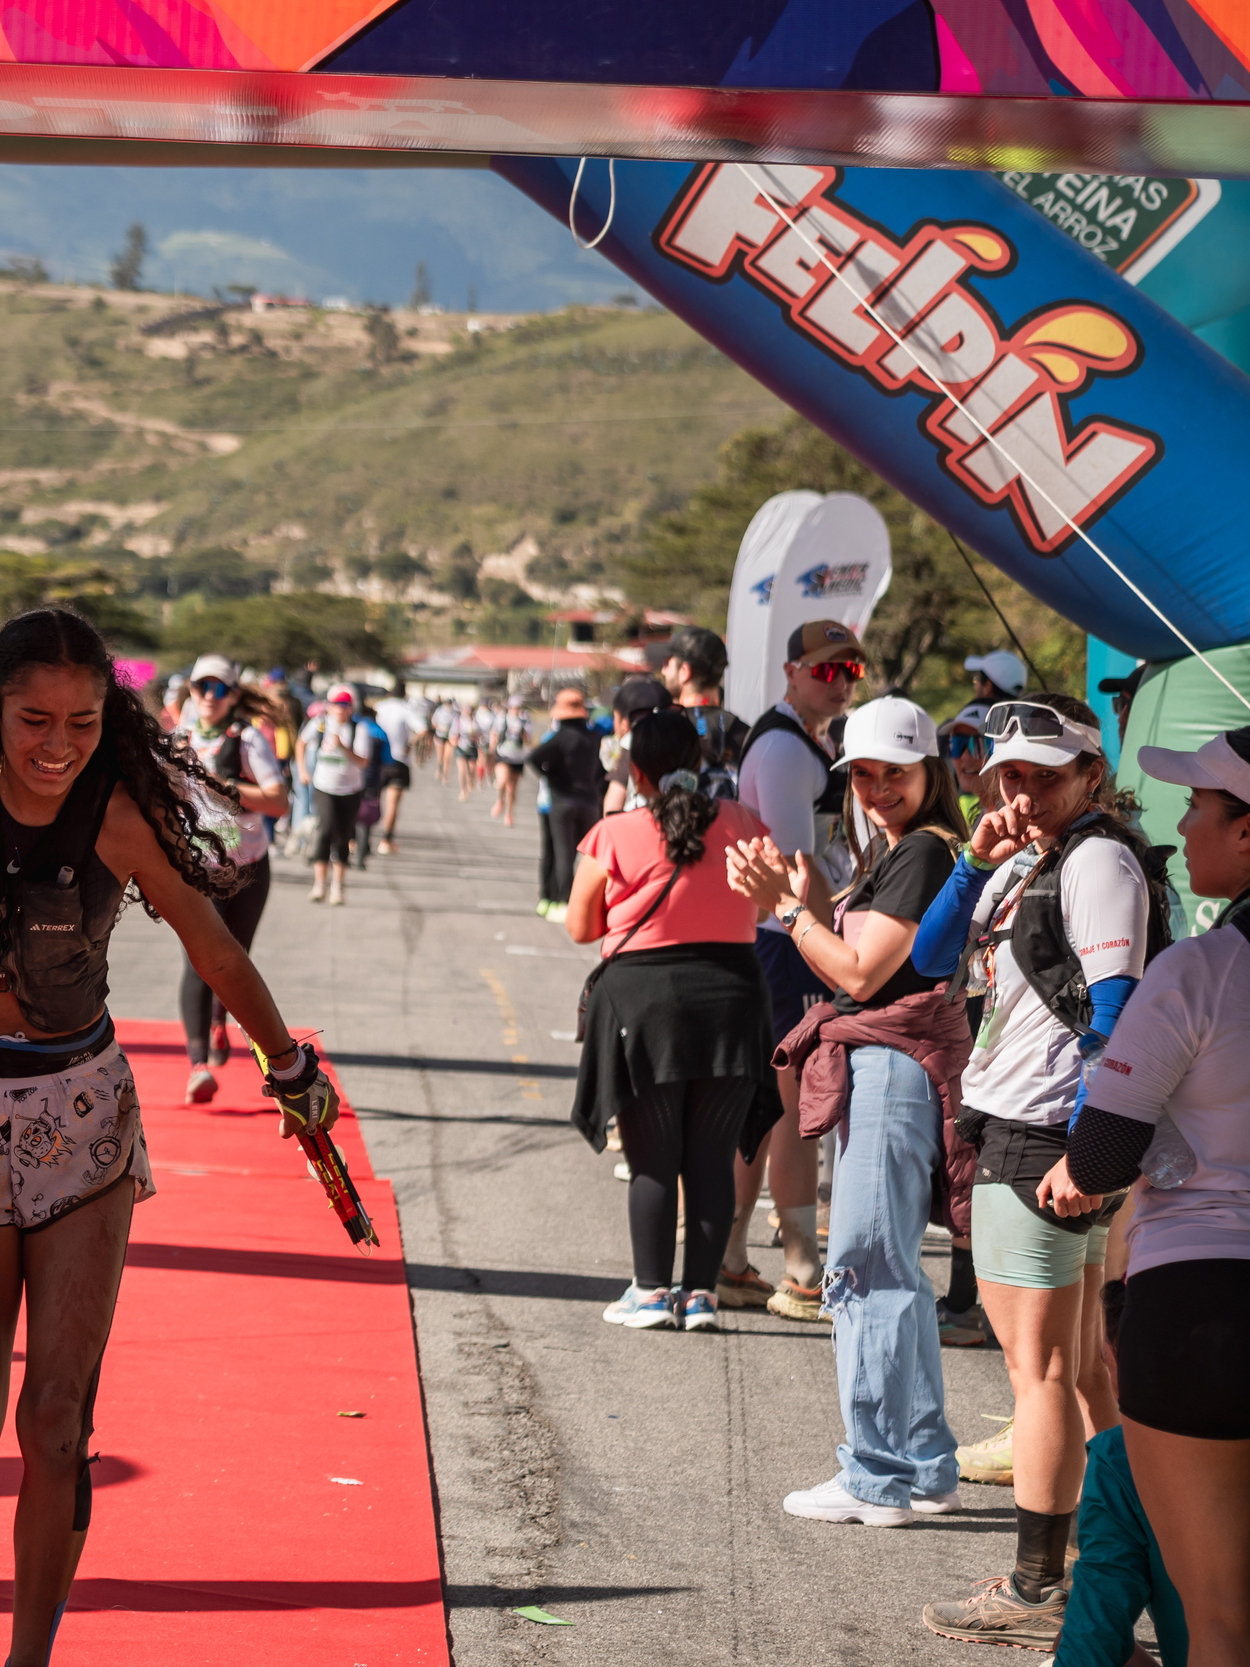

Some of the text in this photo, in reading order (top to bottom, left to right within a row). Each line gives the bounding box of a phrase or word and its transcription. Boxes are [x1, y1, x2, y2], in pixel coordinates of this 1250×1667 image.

[1032, 191, 1119, 261] ARROZ
[666, 163, 1151, 546] FELIPIN
[41, 924, 75, 932] TERREX
[1102, 937, 1130, 950] CORAZÓN
[316, 1160, 341, 1200] LEKI
[328, 1153, 349, 1194] LEKI
